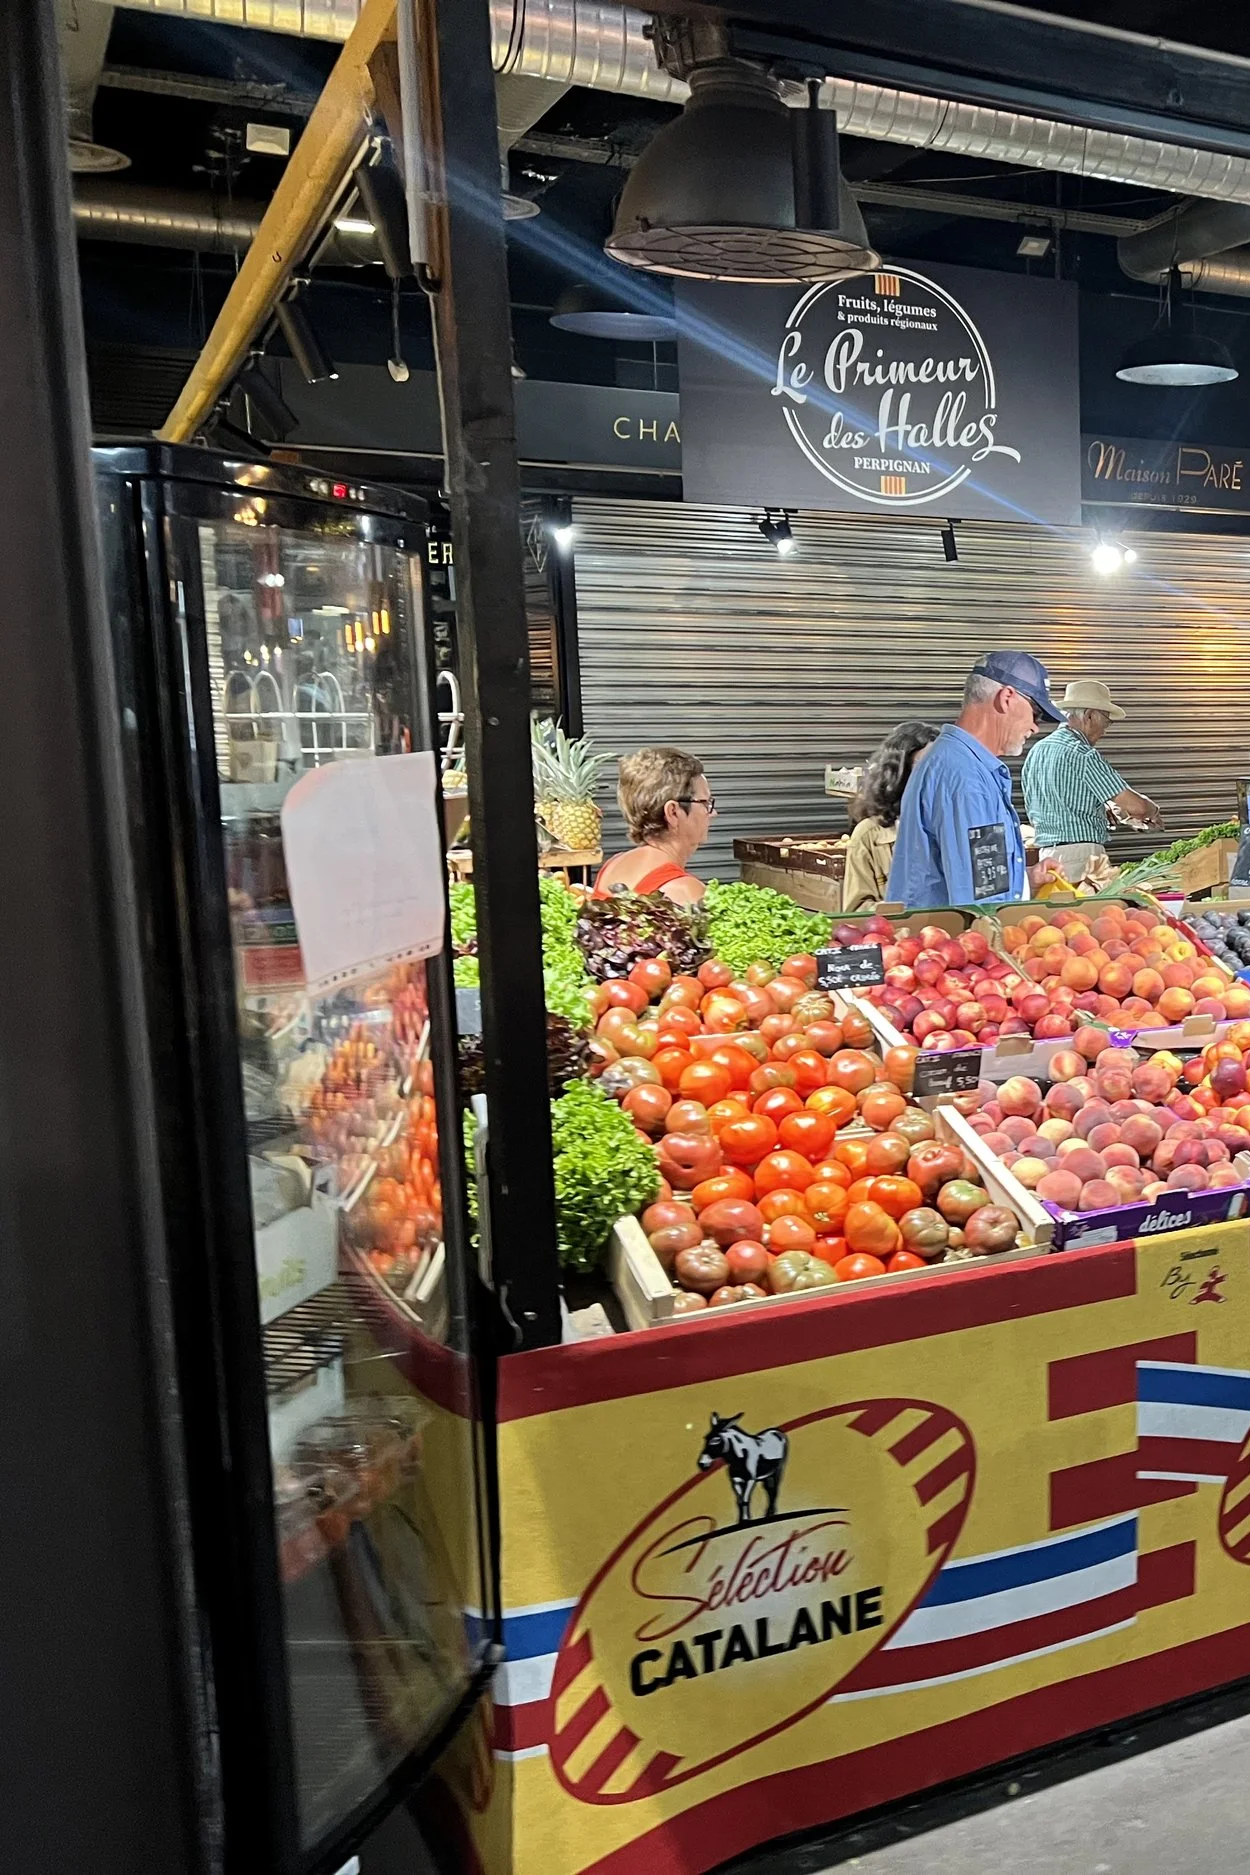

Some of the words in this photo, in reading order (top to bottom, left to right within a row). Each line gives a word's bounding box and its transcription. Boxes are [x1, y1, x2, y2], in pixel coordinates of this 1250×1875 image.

[838, 294, 882, 313] Fruits,
[883, 297, 937, 320] légumes
[838, 312, 846, 322] &
[848, 313, 889, 329] produits
[890, 317, 938, 332] régionaux
[771, 331, 814, 403] Le
[824, 328, 981, 394] Primeur
[613, 416, 681, 443] CHA
[822, 411, 870, 449] des
[873, 387, 1021, 464] Halles
[854, 456, 931, 475] PERPIGNAN
[1088, 440, 1170, 485] Maison
[1138, 1209, 1193, 1234] délices
[632, 1515, 854, 1642] Sélection
[629, 1586, 884, 1697] CATALANE
